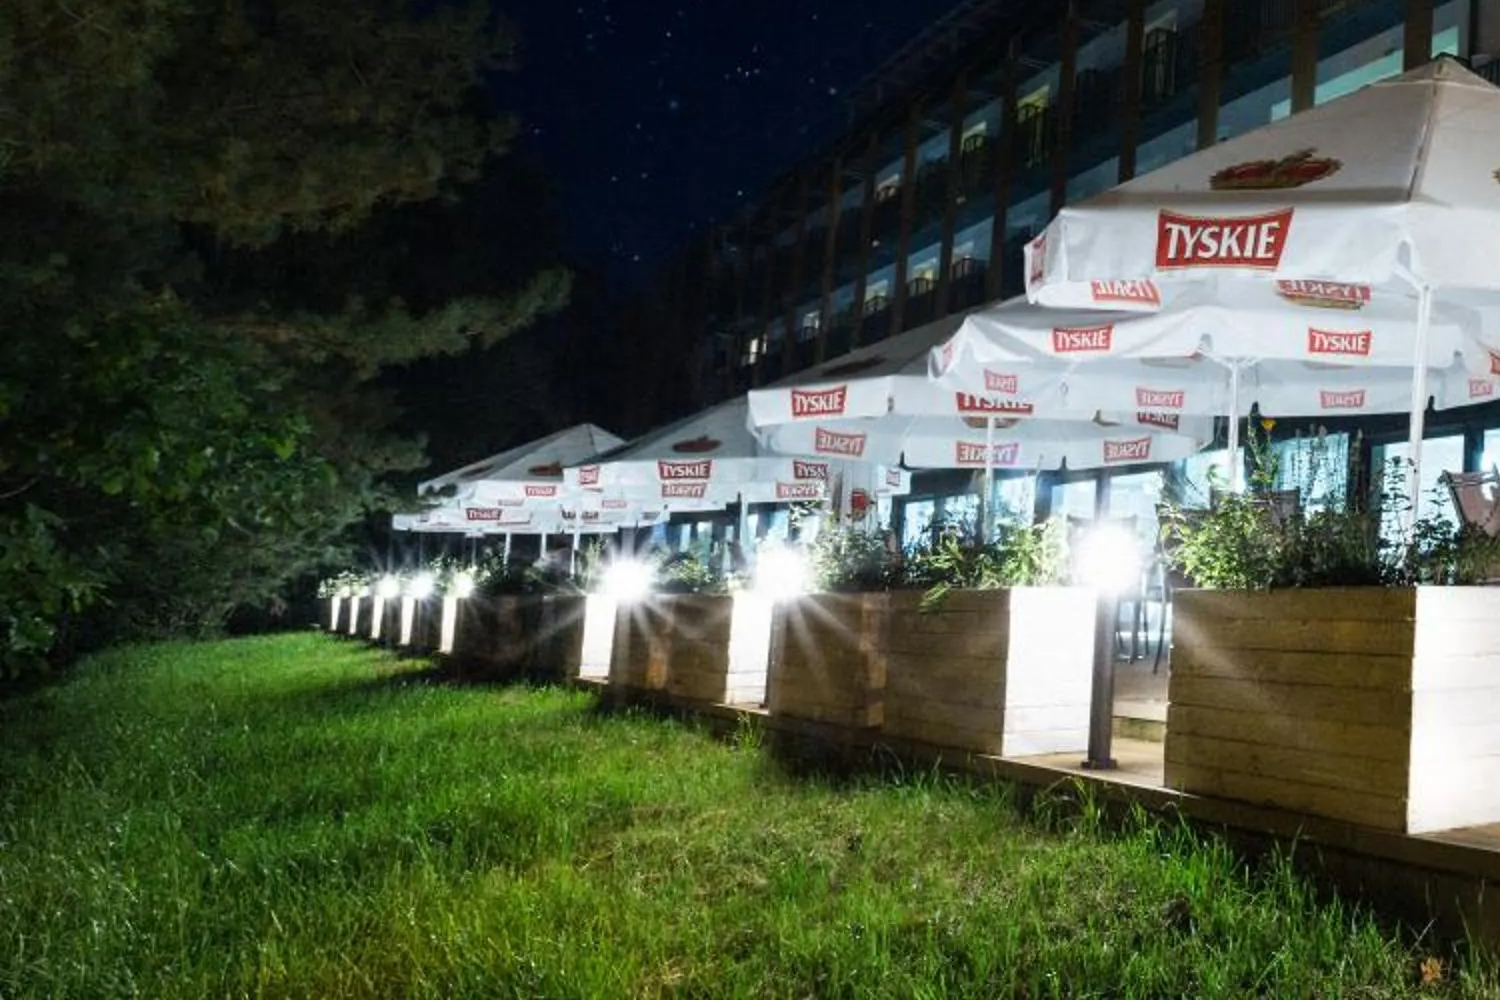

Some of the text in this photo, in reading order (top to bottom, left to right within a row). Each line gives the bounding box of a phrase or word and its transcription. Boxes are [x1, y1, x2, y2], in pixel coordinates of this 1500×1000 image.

[1164, 221, 1281, 260] TYSKIE
[1055, 329, 1108, 350] TYSKIE
[1311, 331, 1367, 352] TYSKIE
[793, 391, 844, 413] TYSKIE
[661, 463, 709, 477] TYSKIE
